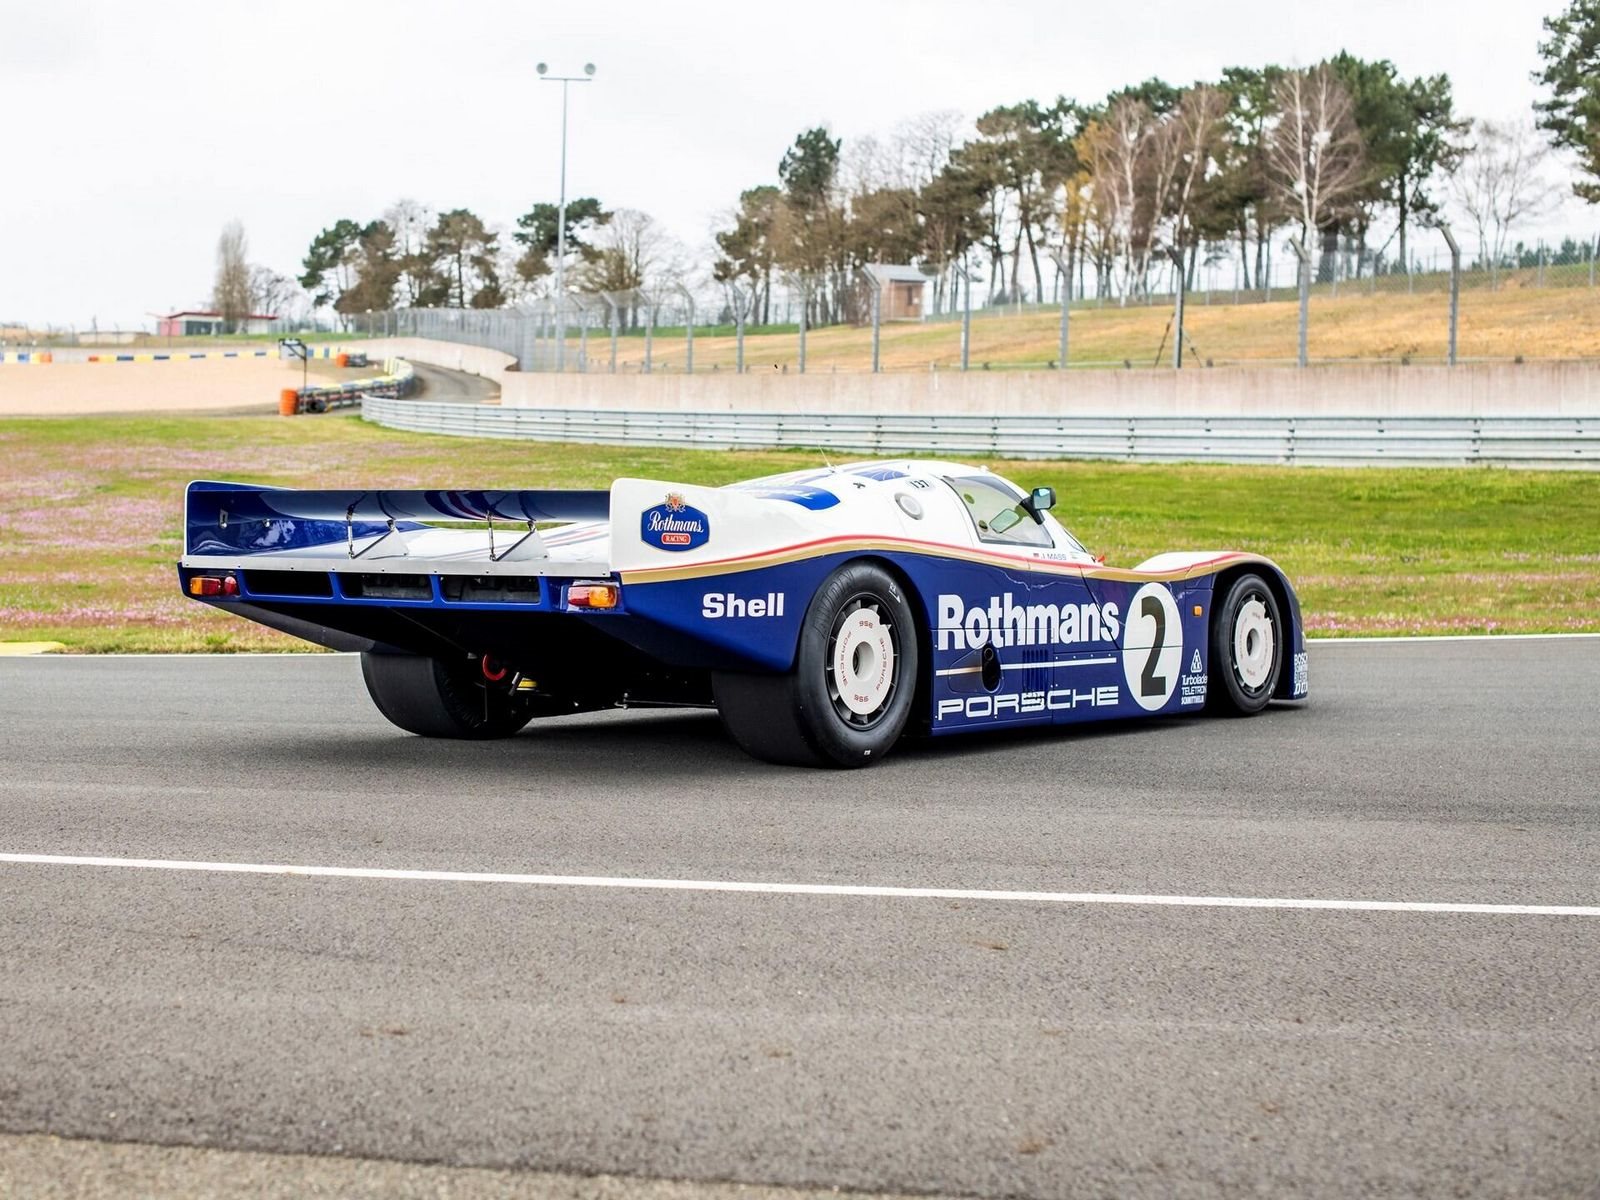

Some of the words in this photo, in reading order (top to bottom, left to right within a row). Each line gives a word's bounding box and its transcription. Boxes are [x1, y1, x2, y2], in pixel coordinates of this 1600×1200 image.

[647, 510, 704, 533] Rothmans
[665, 535, 688, 543] RACING
[702, 592, 785, 618] Shell
[937, 592, 1120, 651] Rothmans
[1140, 595, 1167, 698] 2
[937, 685, 1120, 721] PORSCHE
